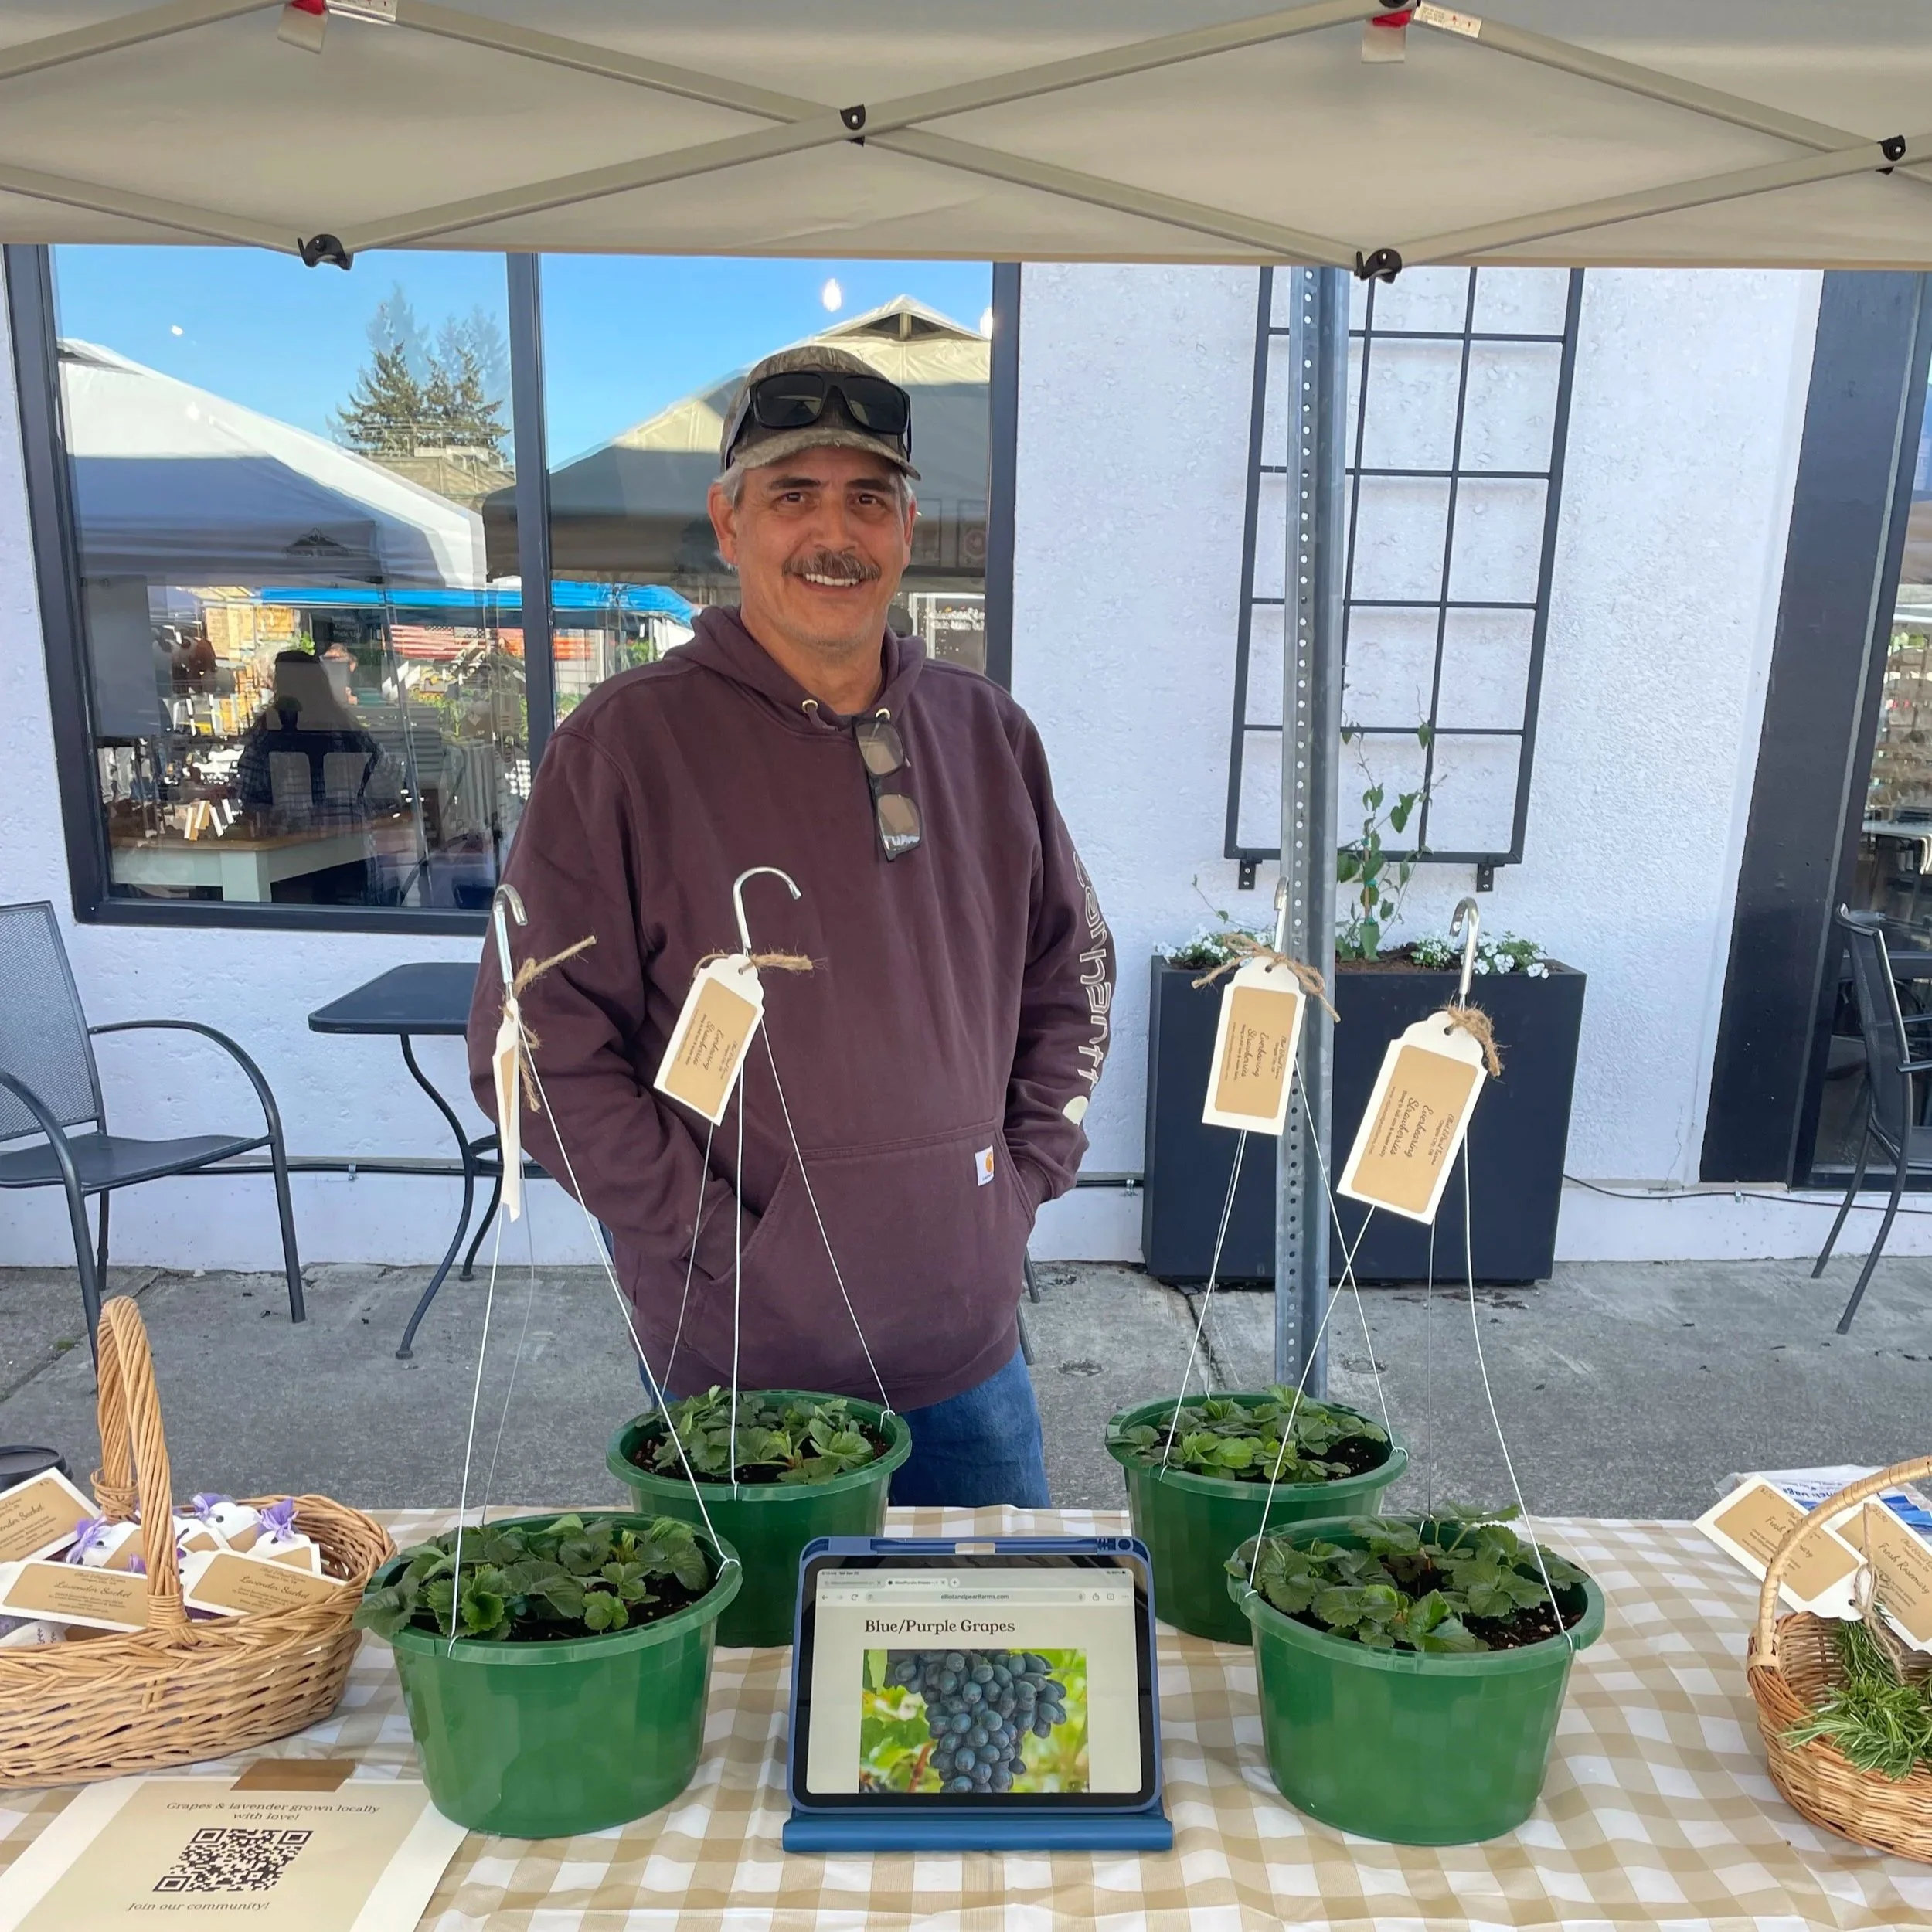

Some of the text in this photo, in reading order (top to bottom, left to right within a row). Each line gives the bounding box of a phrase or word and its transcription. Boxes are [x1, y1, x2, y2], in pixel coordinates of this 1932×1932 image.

[1241, 1028, 1257, 1077] Strawberries
[1390, 1097, 1419, 1155] Strawberries
[1404, 1104, 1434, 1158] Everbearing
[1878, 1543, 1900, 1563] Fresh
[1896, 1561, 1930, 1594] Rosemary
[239, 1576, 278, 1591] Lavender
[281, 1587, 310, 1599] Sachet
[866, 1619, 1015, 1635] Blue/Purple Grapes
[336, 1804, 380, 1814] locally
[127, 1903, 156, 1911] Join
[187, 1902, 270, 1910] community!
